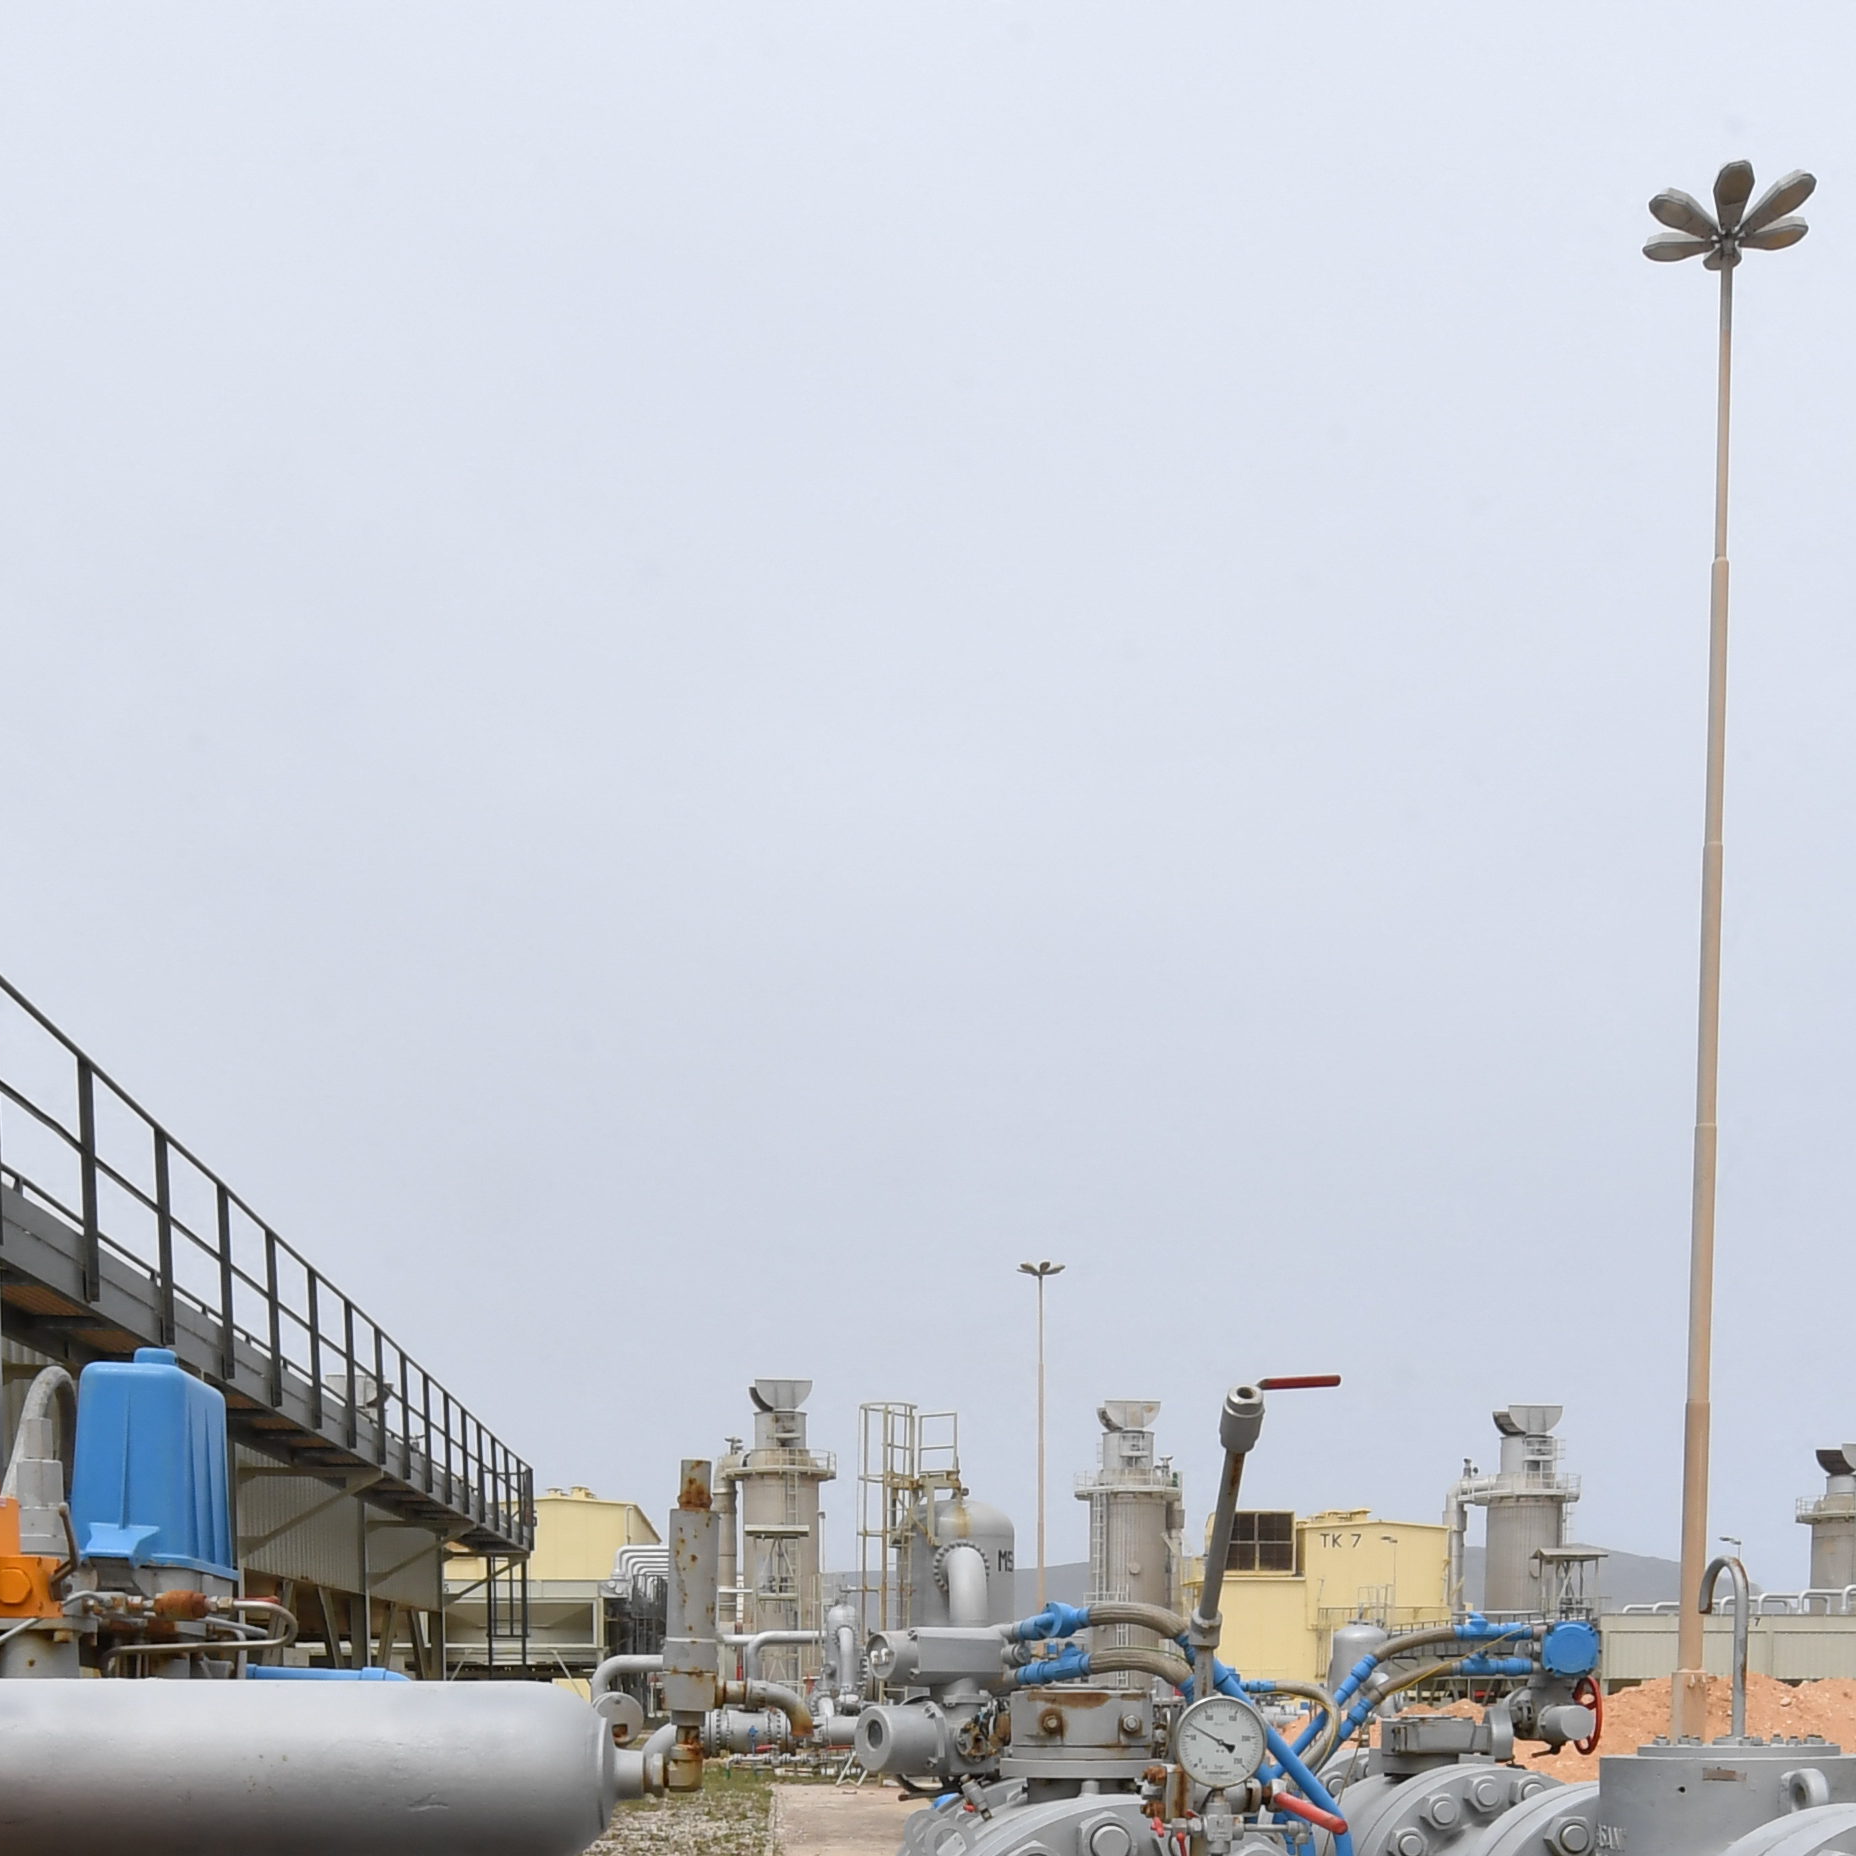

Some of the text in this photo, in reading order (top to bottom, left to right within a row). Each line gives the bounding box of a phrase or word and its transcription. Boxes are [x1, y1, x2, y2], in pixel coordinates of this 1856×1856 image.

[1320, 1533, 1362, 1548] TK 7
[998, 1549, 1014, 1572] MS
